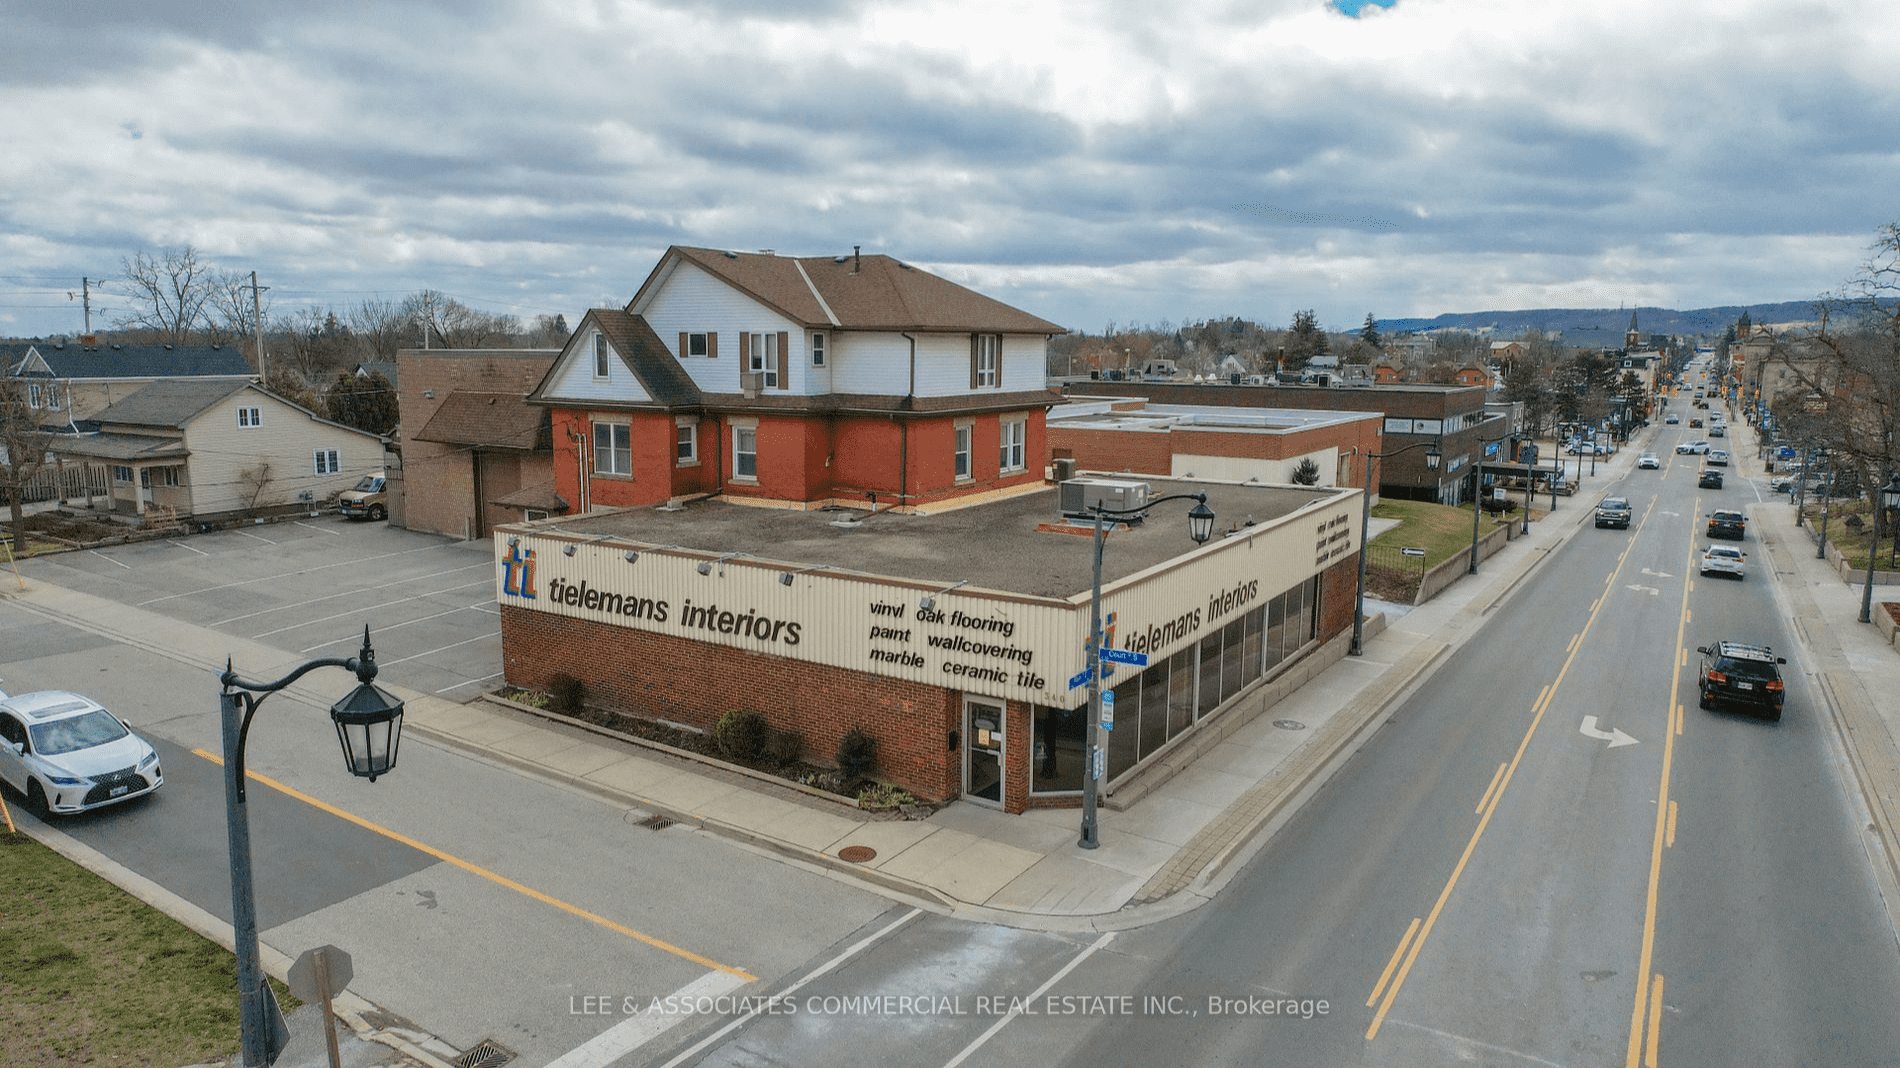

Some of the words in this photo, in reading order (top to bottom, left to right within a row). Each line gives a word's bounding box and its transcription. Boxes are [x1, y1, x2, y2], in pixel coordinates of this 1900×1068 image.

[549, 578, 669, 623] tielemans
[681, 599, 802, 646] interiors
[916, 609, 946, 624] oak
[951, 610, 1015, 638] flooring
[1125, 607, 1201, 654] tielemans
[1207, 579, 1259, 623] interiors
[869, 625, 912, 643] paint
[928, 635, 1033, 666] wallcovering
[869, 648, 925, 668] marble
[942, 661, 1008, 684] ceramic
[1017, 671, 1045, 690] tile
